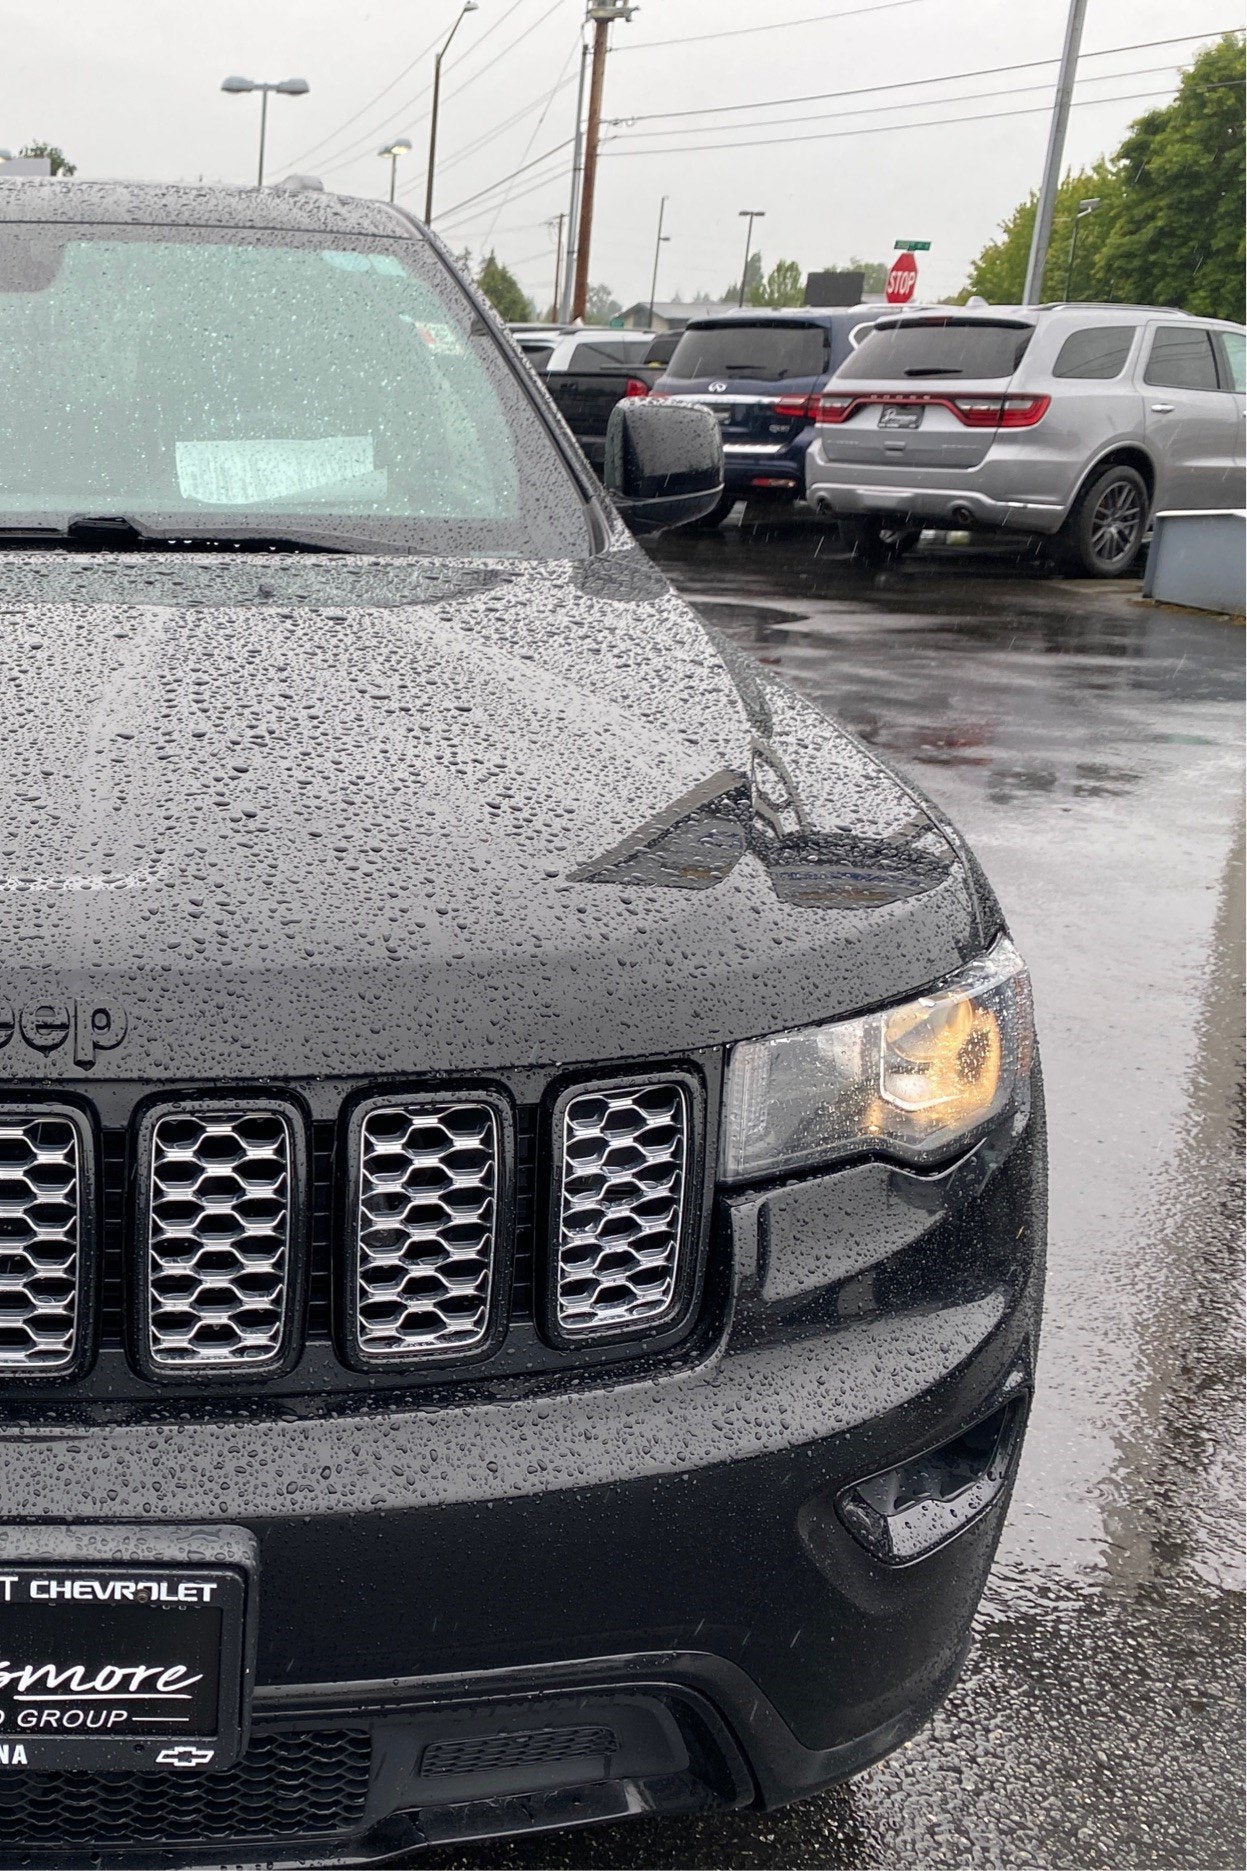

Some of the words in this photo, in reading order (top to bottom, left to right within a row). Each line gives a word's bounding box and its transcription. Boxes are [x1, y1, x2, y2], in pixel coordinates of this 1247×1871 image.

[888, 271, 916, 294] STOP
[30, 1580, 218, 1602] CHEVROLET
[17, 1709, 128, 1729] GROUP
